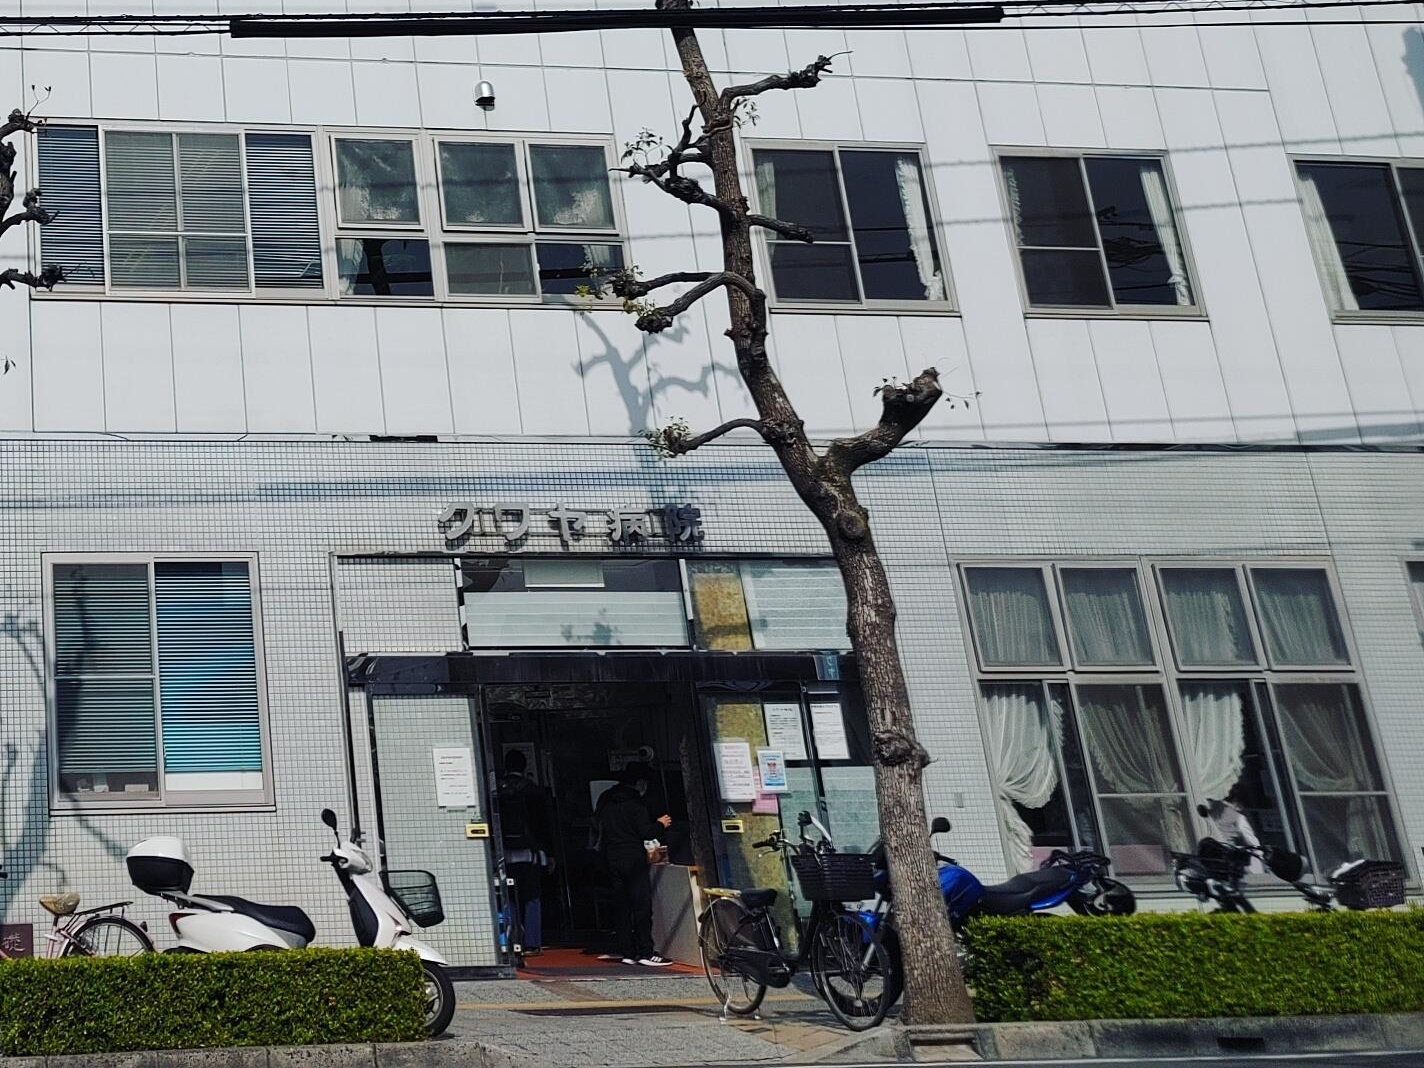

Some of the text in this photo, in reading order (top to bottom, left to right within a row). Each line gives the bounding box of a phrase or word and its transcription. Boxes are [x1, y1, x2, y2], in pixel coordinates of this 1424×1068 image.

[438, 501, 704, 542] クワヤ病院
